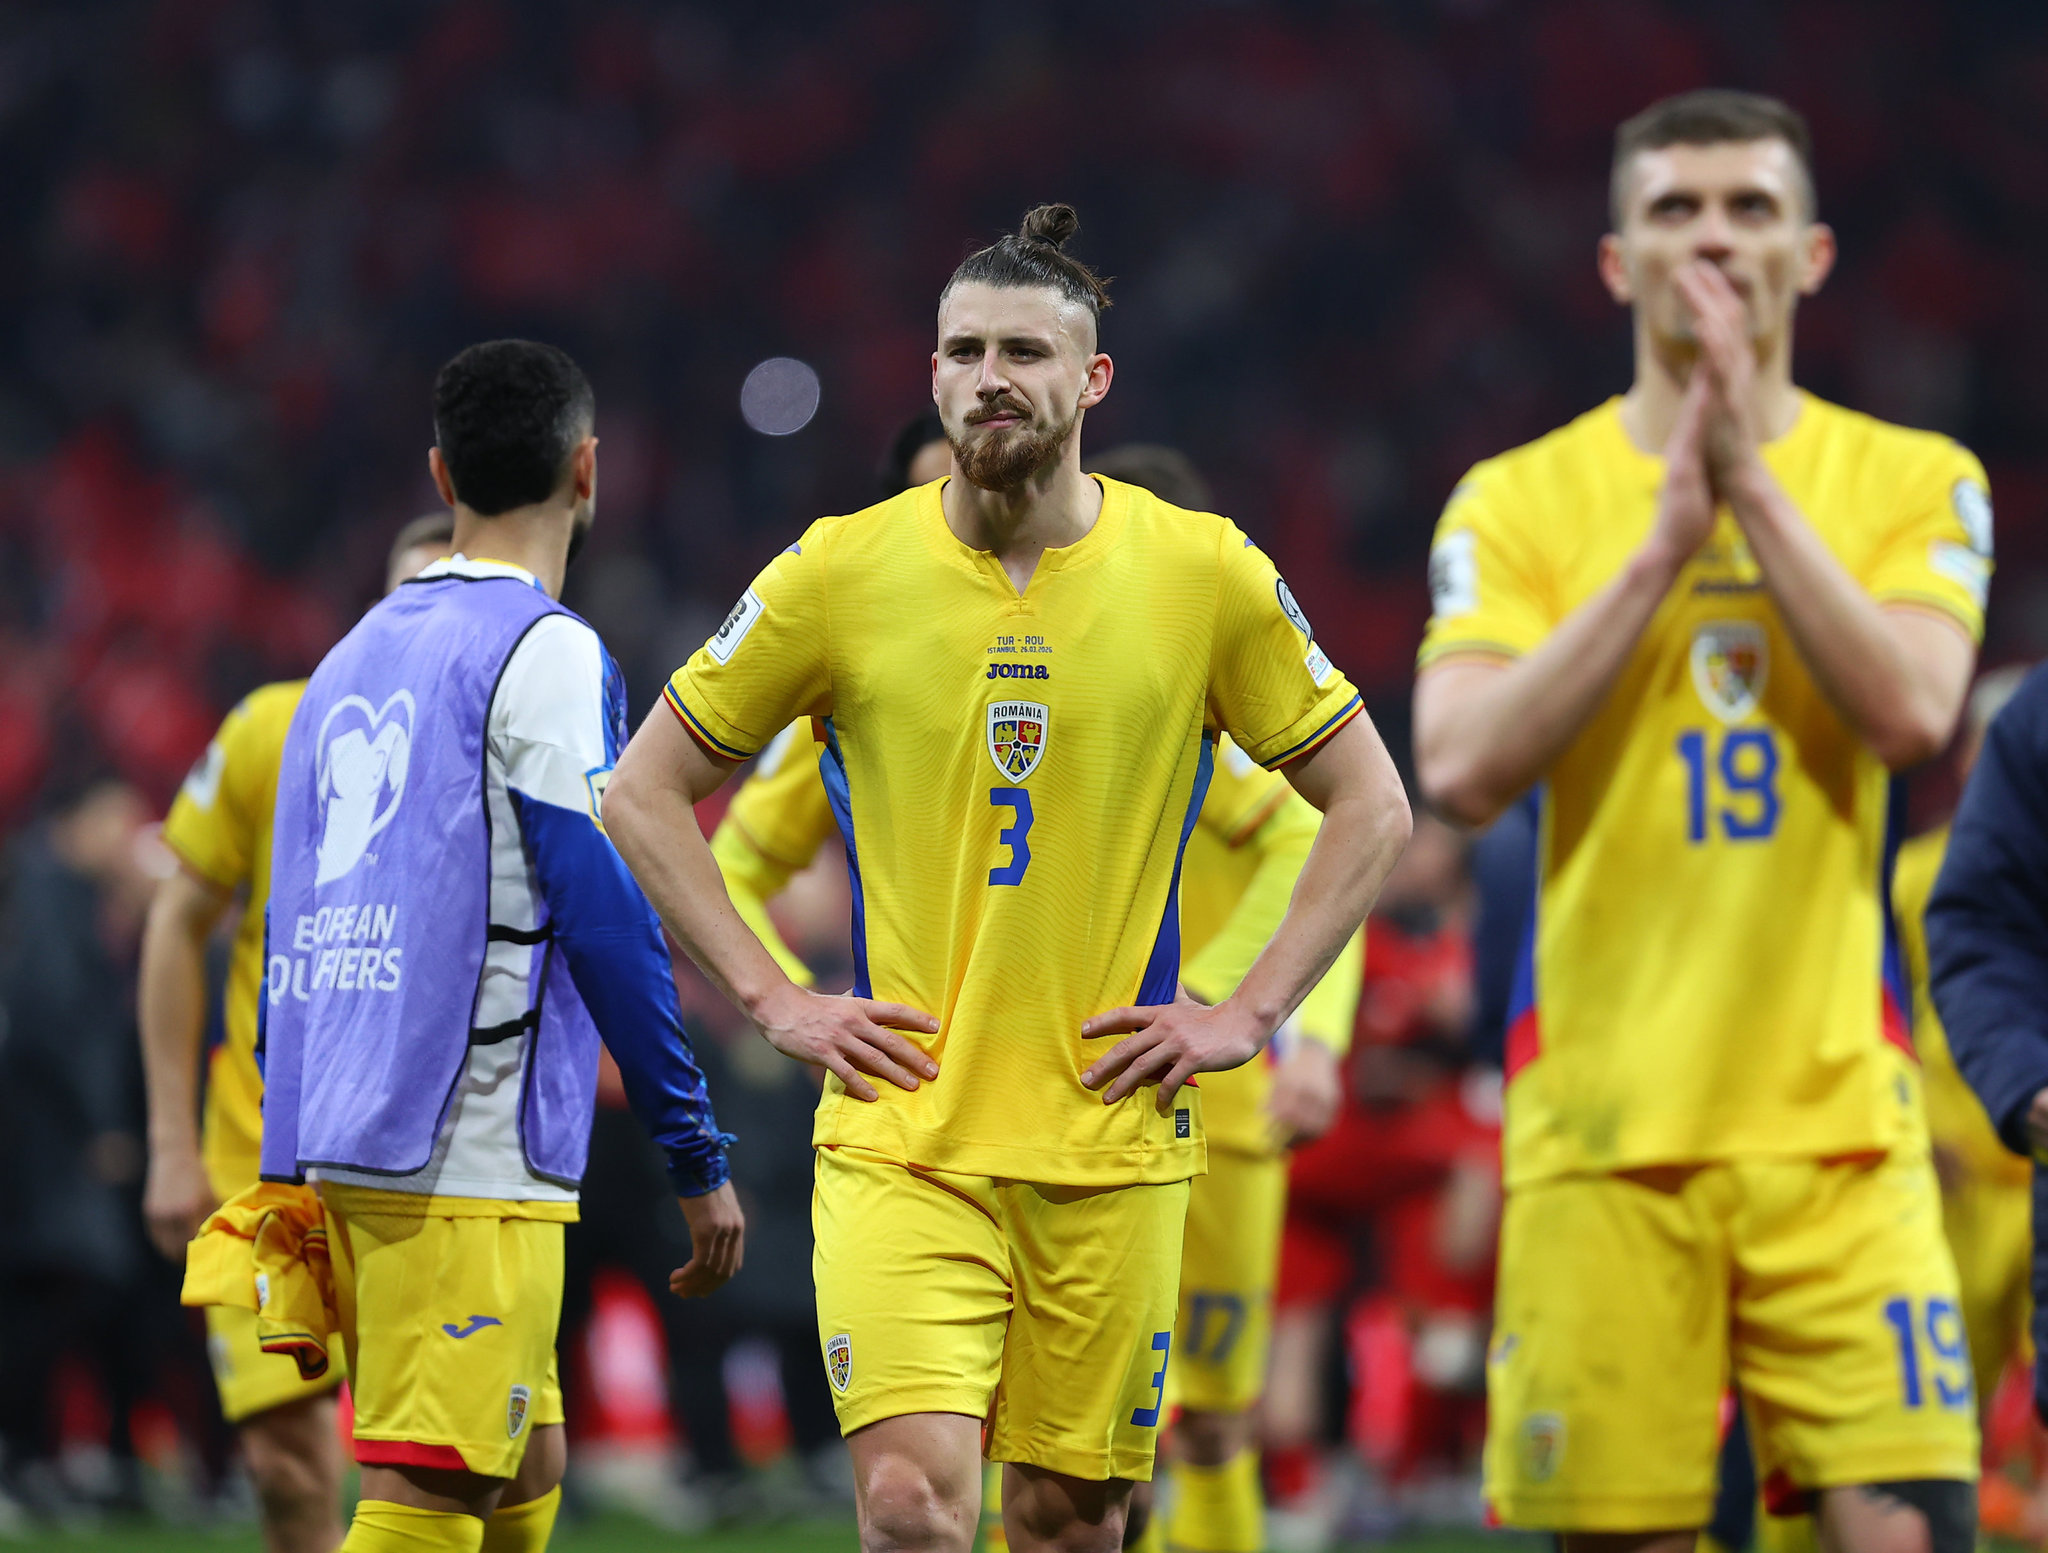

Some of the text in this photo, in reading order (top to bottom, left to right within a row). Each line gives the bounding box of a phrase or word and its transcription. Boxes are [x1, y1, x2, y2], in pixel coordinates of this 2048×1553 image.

[996, 635, 1015, 646] TUR
[1025, 635, 1044, 645] ROU
[993, 702, 1042, 720] ROMÂNIA
[1676, 728, 1781, 842] 19
[988, 787, 1035, 887] 3
[1184, 1289, 1247, 1366] 17
[1884, 1297, 1974, 1409] 19
